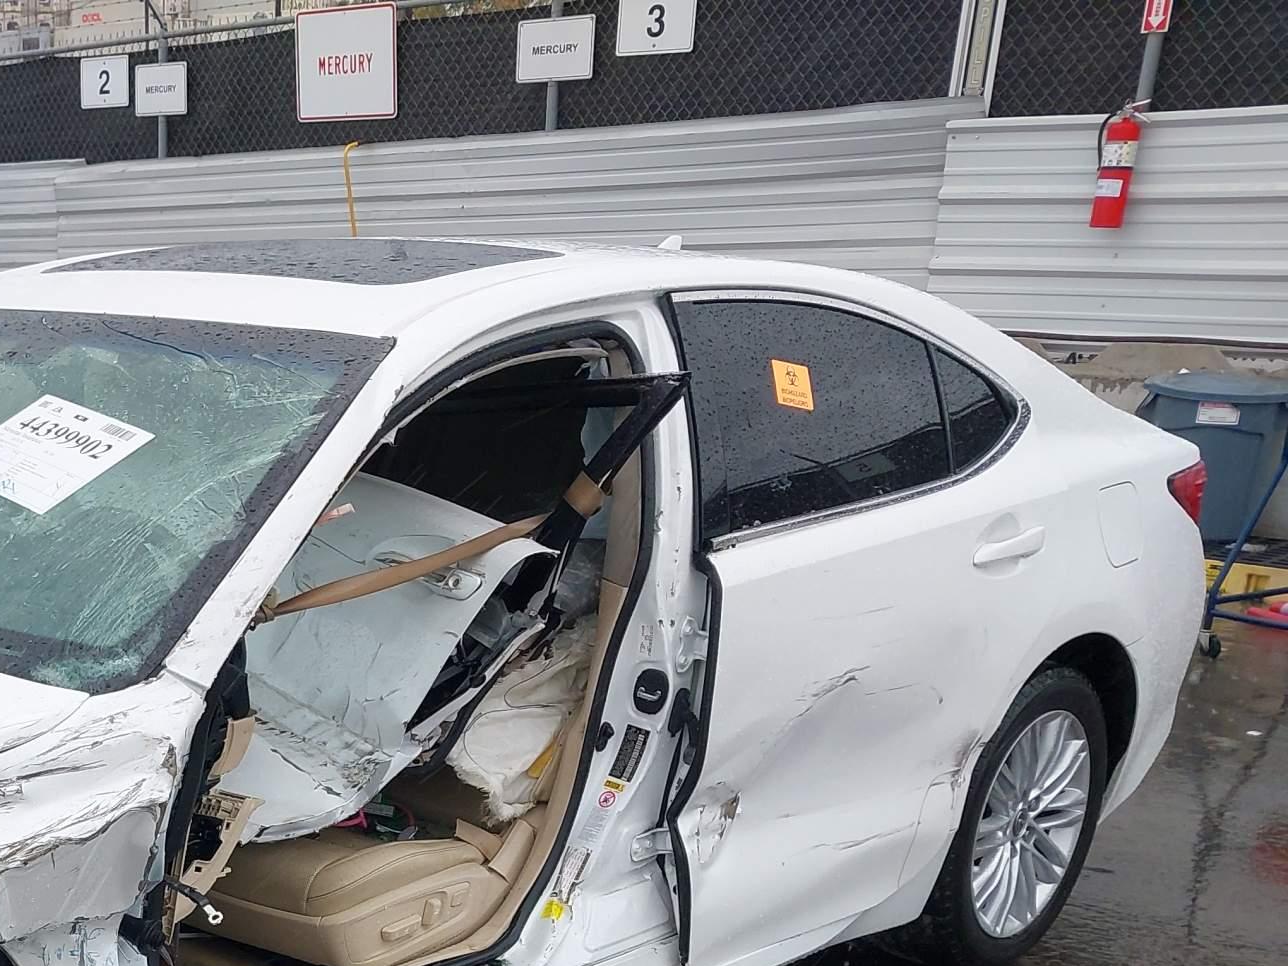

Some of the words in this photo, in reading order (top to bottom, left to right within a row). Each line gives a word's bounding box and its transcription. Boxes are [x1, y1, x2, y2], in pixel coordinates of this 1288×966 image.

[646, 4, 666, 38] 3
[532, 43, 578, 56] MERCURY
[971, 0, 993, 84] PILL
[318, 53, 373, 76] MERCURY
[99, 70, 111, 95] 2
[145, 84, 177, 94] MERCURY
[19, 416, 113, 459] 44399902
